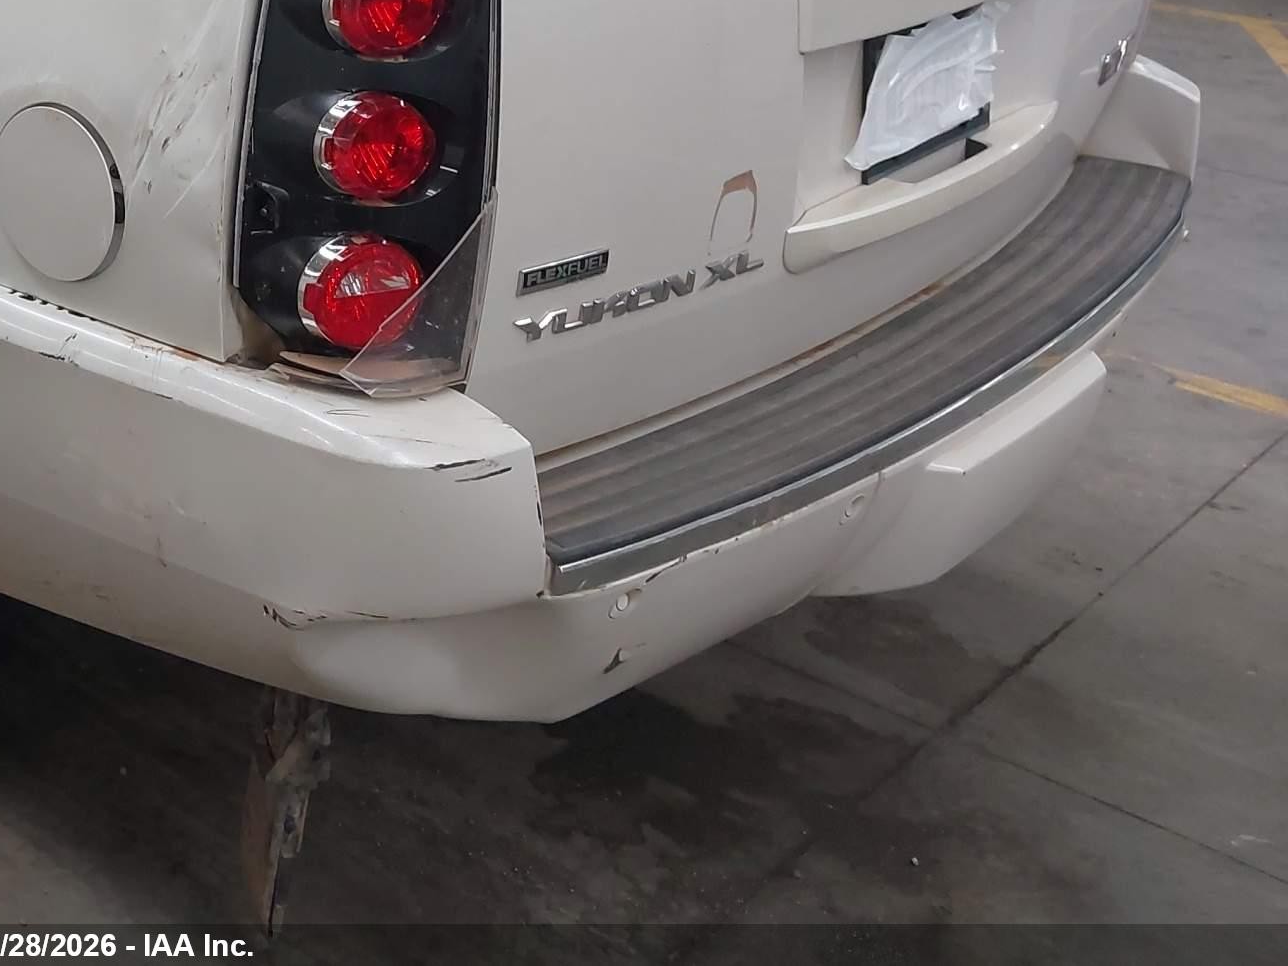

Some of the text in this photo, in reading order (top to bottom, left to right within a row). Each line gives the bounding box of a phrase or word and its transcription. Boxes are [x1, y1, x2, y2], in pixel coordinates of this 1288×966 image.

[512, 250, 764, 343] YUKON XL
[525, 252, 608, 287] FLEXFUEL
